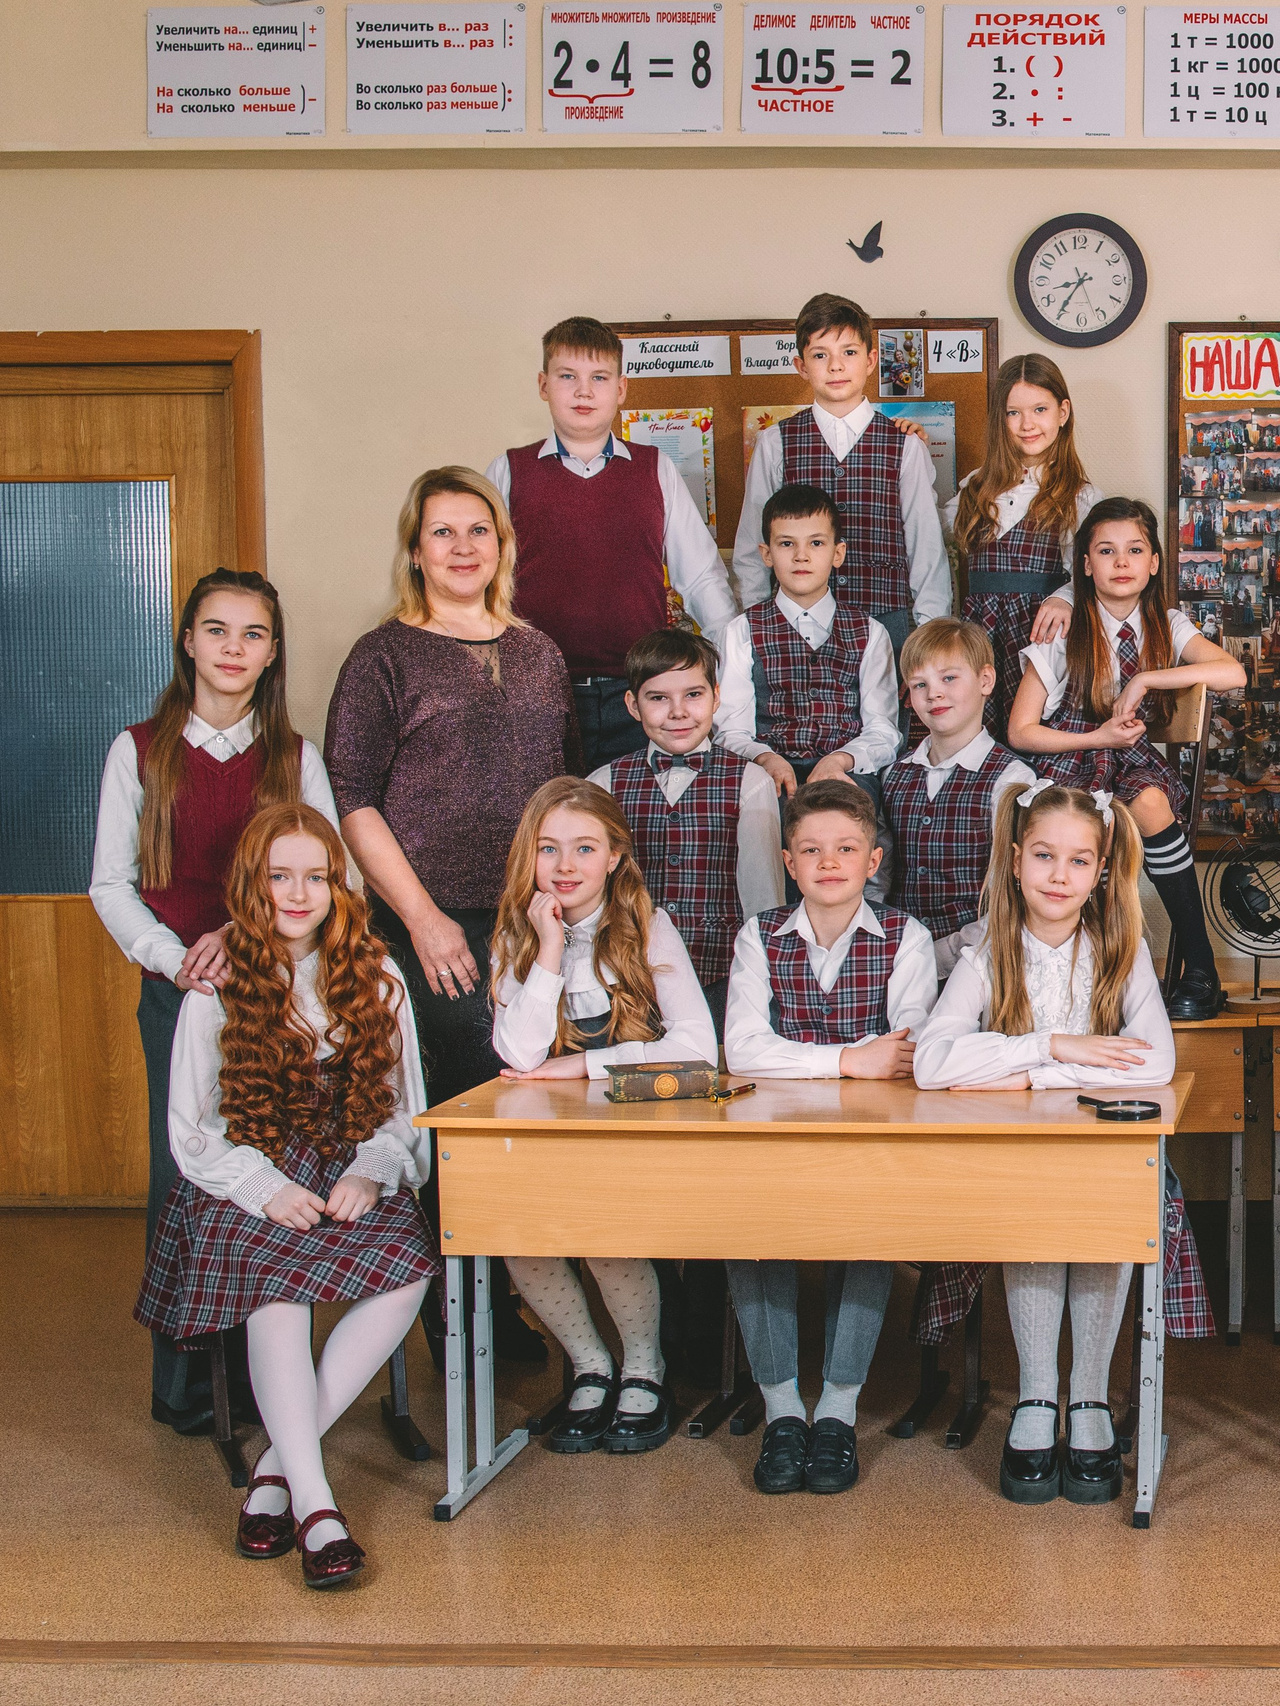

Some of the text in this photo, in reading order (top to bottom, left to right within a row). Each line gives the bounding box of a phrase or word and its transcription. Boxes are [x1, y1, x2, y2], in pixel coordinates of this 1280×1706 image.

[551, 12, 716, 25] МНОЖИТЕЛЬ МНОЖИТЕЛЬ ПРОИЗВЕДЕНИЕ
[754, 15, 910, 31] ДЕЛИМОЕ ДЕЛИТЕЛЬ ЧАСТНОЕ
[976, 14, 1099, 30] ПОРЯДОК
[1184, 13, 1267, 24] МЕРЫ МАССЫ
[156, 25, 220, 35] Увеличить
[253, 26, 297, 36] единиц
[356, 22, 434, 32] Увеличить
[465, 23, 488, 34] раз
[356, 38, 439, 48] Уменьшить
[470, 40, 494, 50] раз
[967, 29, 1105, 47] ДЕЙСТВИЙ
[1171, 33, 1180, 48] 1
[1187, 37, 1197, 48] т
[1227, 33, 1273, 49] 1000
[156, 41, 224, 51] Уменьшить
[257, 42, 302, 52] единиц
[554, 41, 572, 88] 2
[611, 41, 631, 88] 4
[692, 40, 711, 88] 8
[891, 50, 911, 85] 2
[994, 56, 1015, 73] 1.
[1171, 58, 1180, 72] 1
[1188, 61, 1208, 73] кг
[157, 85, 290, 97] На сколько больше
[357, 82, 497, 95] Во сколько раз больше
[993, 83, 1014, 99] 2.
[1171, 82, 1180, 97] 1
[1188, 86, 1199, 100] ц
[1234, 82, 1269, 98] 100
[157, 103, 295, 113] На сколько меньше
[356, 100, 498, 112] Во сколько раз меньше
[758, 100, 833, 112] ЧАСТНОЕ
[565, 106, 623, 121] ПРОИЗВЕДЕНИЕ
[992, 110, 1014, 127] 3.
[1170, 107, 1180, 122] 1
[1187, 111, 1197, 122] т
[1226, 107, 1248, 123] 10
[1256, 111, 1267, 125] ц
[1054, 240, 1068, 256] 11
[1072, 234, 1089, 249] 12
[1094, 240, 1104, 254] 1
[1040, 253, 1056, 270] 10
[1105, 253, 1120, 266] 2
[1035, 276, 1050, 286] 9
[1112, 274, 1126, 286] 3
[1041, 294, 1055, 307] 8
[1108, 294, 1122, 308] 4
[1076, 312, 1087, 327] 6
[1095, 307, 1106, 321] 5
[639, 341, 699, 353] Классный
[933, 340, 981, 362] 4 «В»
[626, 357, 714, 373] руководитель
[744, 357, 778, 370] Влада
[1190, 338, 1280, 392] НАША
